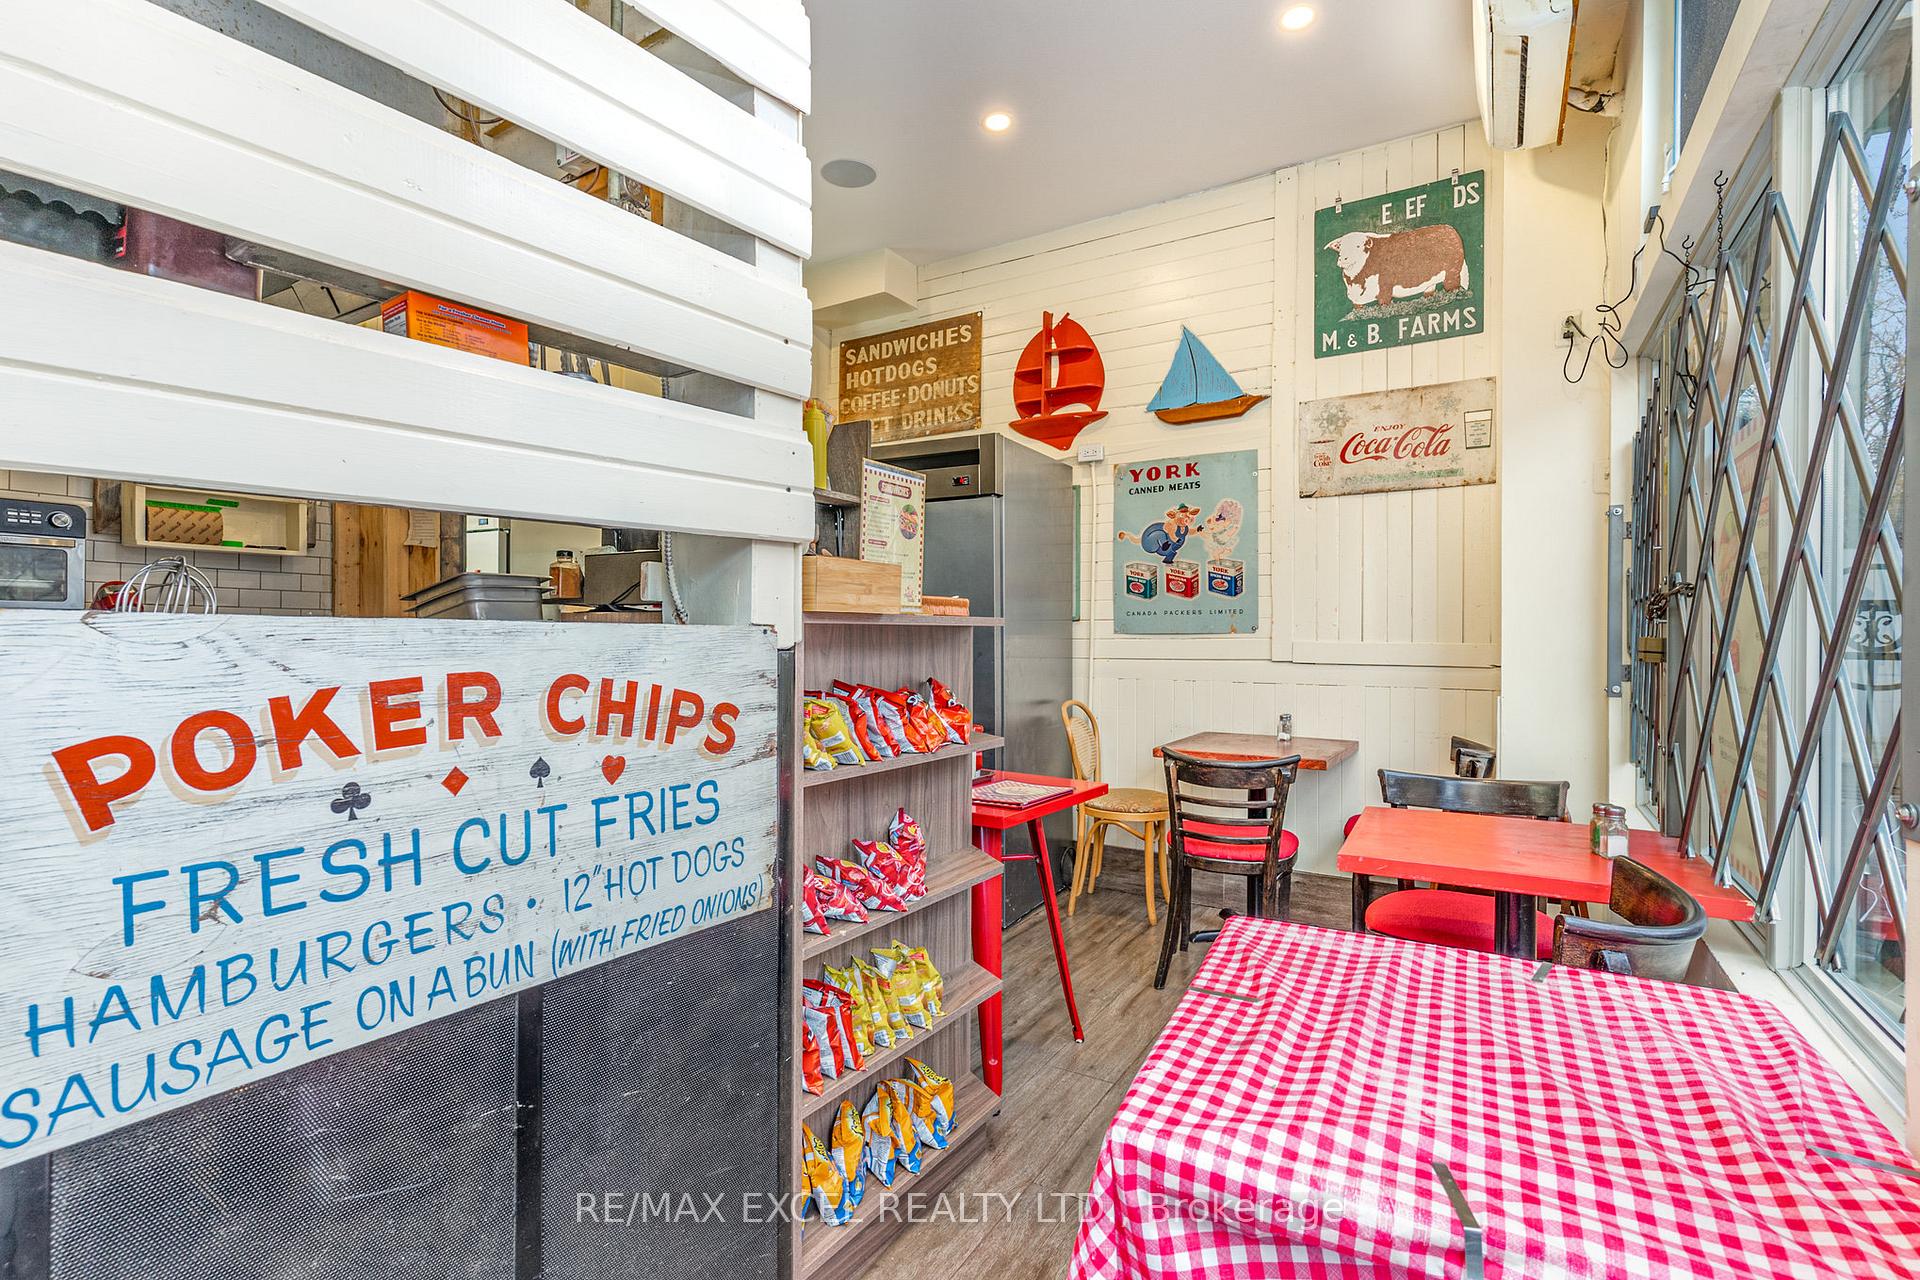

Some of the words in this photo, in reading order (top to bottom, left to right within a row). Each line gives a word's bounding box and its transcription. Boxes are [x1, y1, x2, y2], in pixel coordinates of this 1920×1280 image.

[845, 325, 972, 366] SANDWICHES
[1322, 332, 1341, 352] M.
[1347, 334, 1357, 348] &
[1367, 323, 1383, 345] B.
[1398, 306, 1477, 341] FARMS
[846, 357, 937, 390] HOTDOGS
[901, 402, 973, 431] DRINKS
[1373, 424, 1406, 432] ENJOY
[1340, 424, 1455, 464] Coca-Cola
[1129, 462, 1200, 483] YORK
[1129, 485, 1164, 495] CANNED
[1169, 481, 1200, 492] MEATS
[50, 671, 503, 834] POKER
[546, 673, 741, 757] CHIPS
[112, 828, 421, 947] FRESH
[453, 803, 568, 875] CUT
[591, 779, 720, 848] FRIES
[25, 893, 505, 1057] HAMBURGERS
[672, 836, 745, 883] DOGS
[0, 1000, 334, 1149] SAUSAGE
[357, 976, 415, 1031] ON
[428, 965, 457, 1009] A
[464, 941, 534, 998] BUN
[552, 924, 617, 979] (WITH
[621, 902, 686, 948] FRIED
[691, 873, 764, 923] ONIONS)
